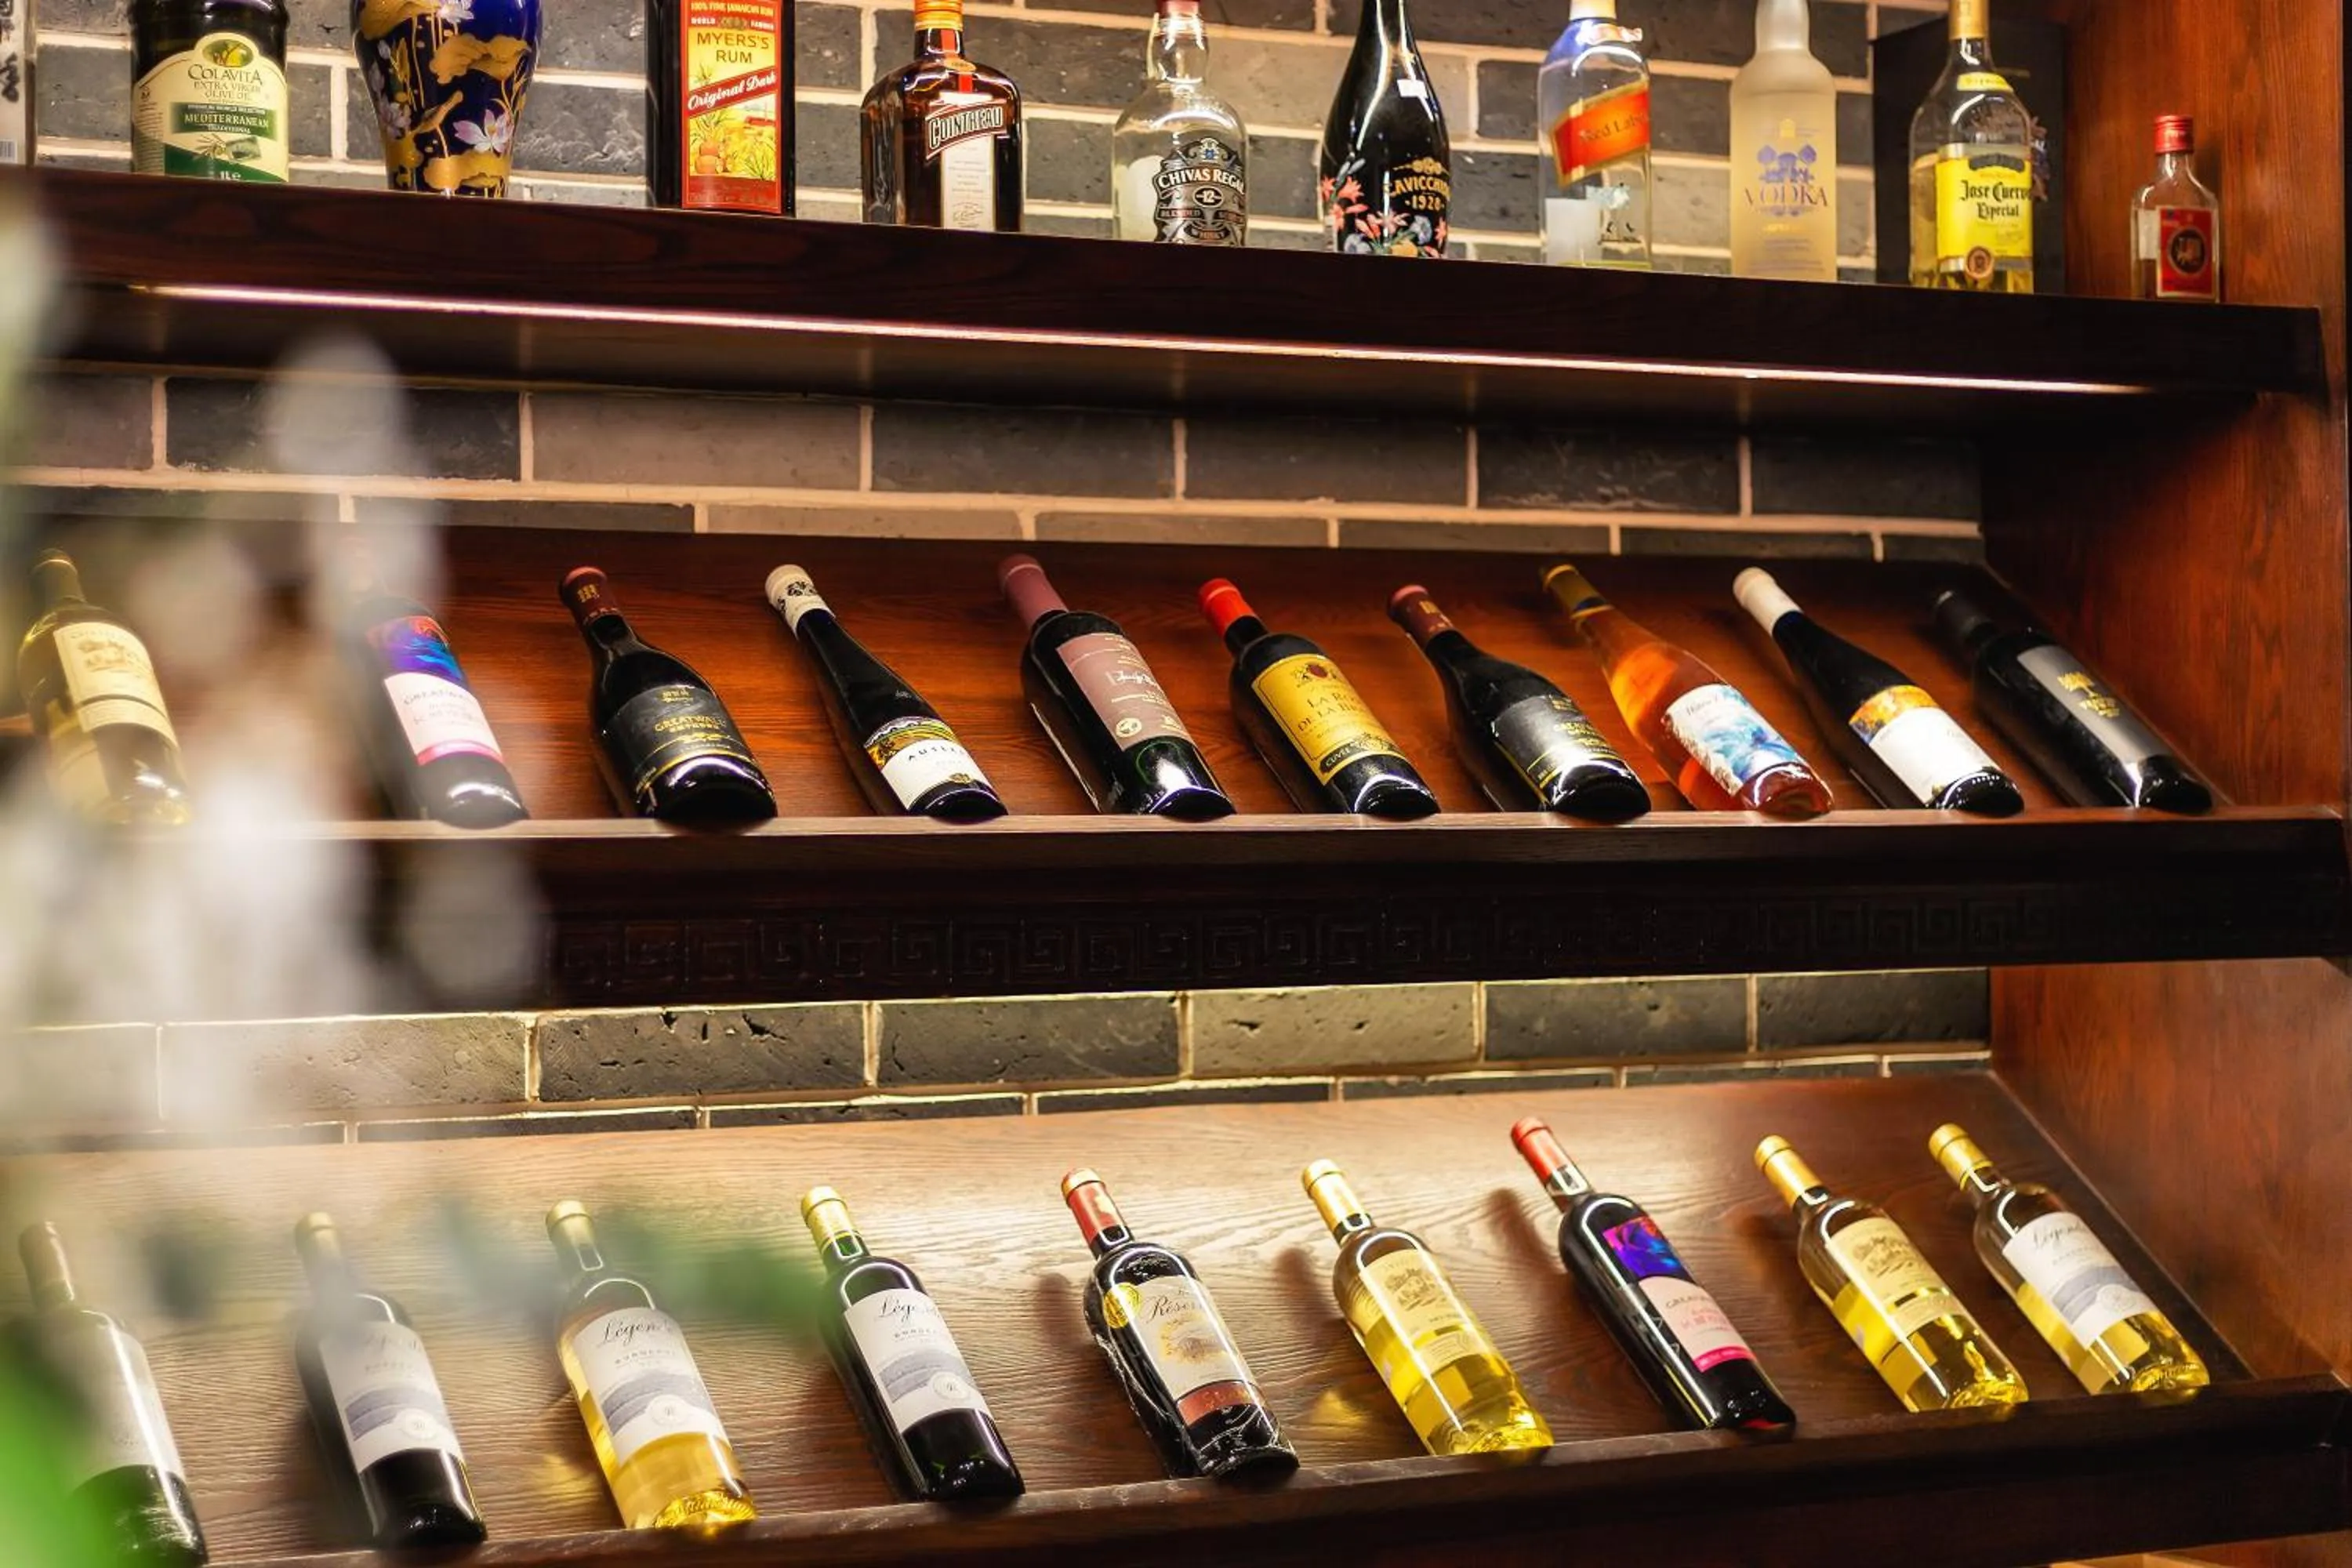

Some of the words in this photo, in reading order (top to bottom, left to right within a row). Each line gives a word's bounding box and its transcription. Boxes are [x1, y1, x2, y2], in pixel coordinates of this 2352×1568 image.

[697, 32, 769, 49] MYERS'S
[716, 49, 753, 63] RUM
[187, 64, 263, 85] COLAVITA
[688, 79, 745, 110] Original
[746, 71, 776, 91] Dark
[184, 114, 268, 129] MEDITERRANEAN
[929, 107, 1004, 150] COINTREAU
[1580, 122, 1611, 143] Red
[1158, 169, 1210, 188] CHIVAS
[1213, 169, 1245, 194] REGAL
[1961, 180, 1989, 201] Jose
[1203, 190, 1214, 203] 12
[1744, 185, 1828, 208] VODKA
